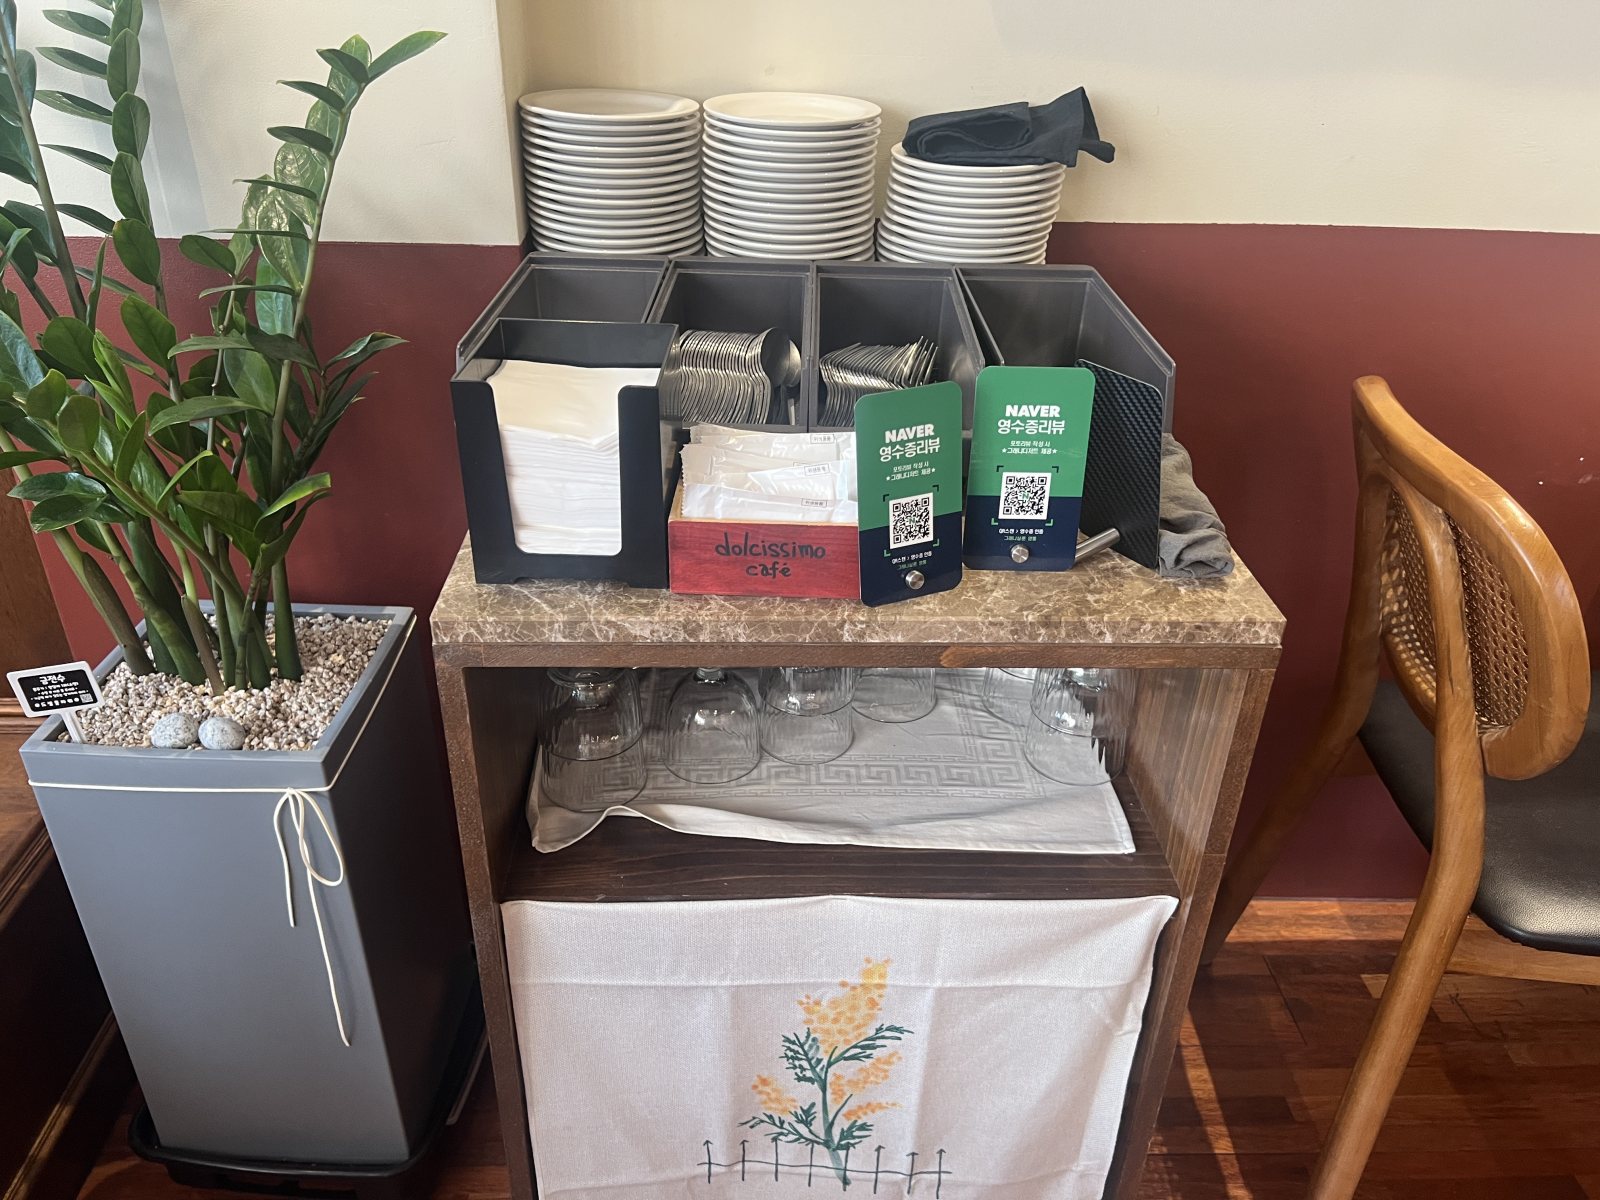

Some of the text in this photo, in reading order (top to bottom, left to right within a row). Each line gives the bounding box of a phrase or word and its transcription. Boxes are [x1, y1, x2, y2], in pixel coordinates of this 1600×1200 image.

[1005, 404, 1060, 418] NAVER
[885, 424, 934, 444] NAVER
[997, 419, 1066, 435] 영수증리뷰
[879, 437, 941, 462] 영수증리뷰
[715, 531, 827, 559] dolcissimo
[745, 562, 792, 579] café
[39, 674, 66, 685] 금전수
